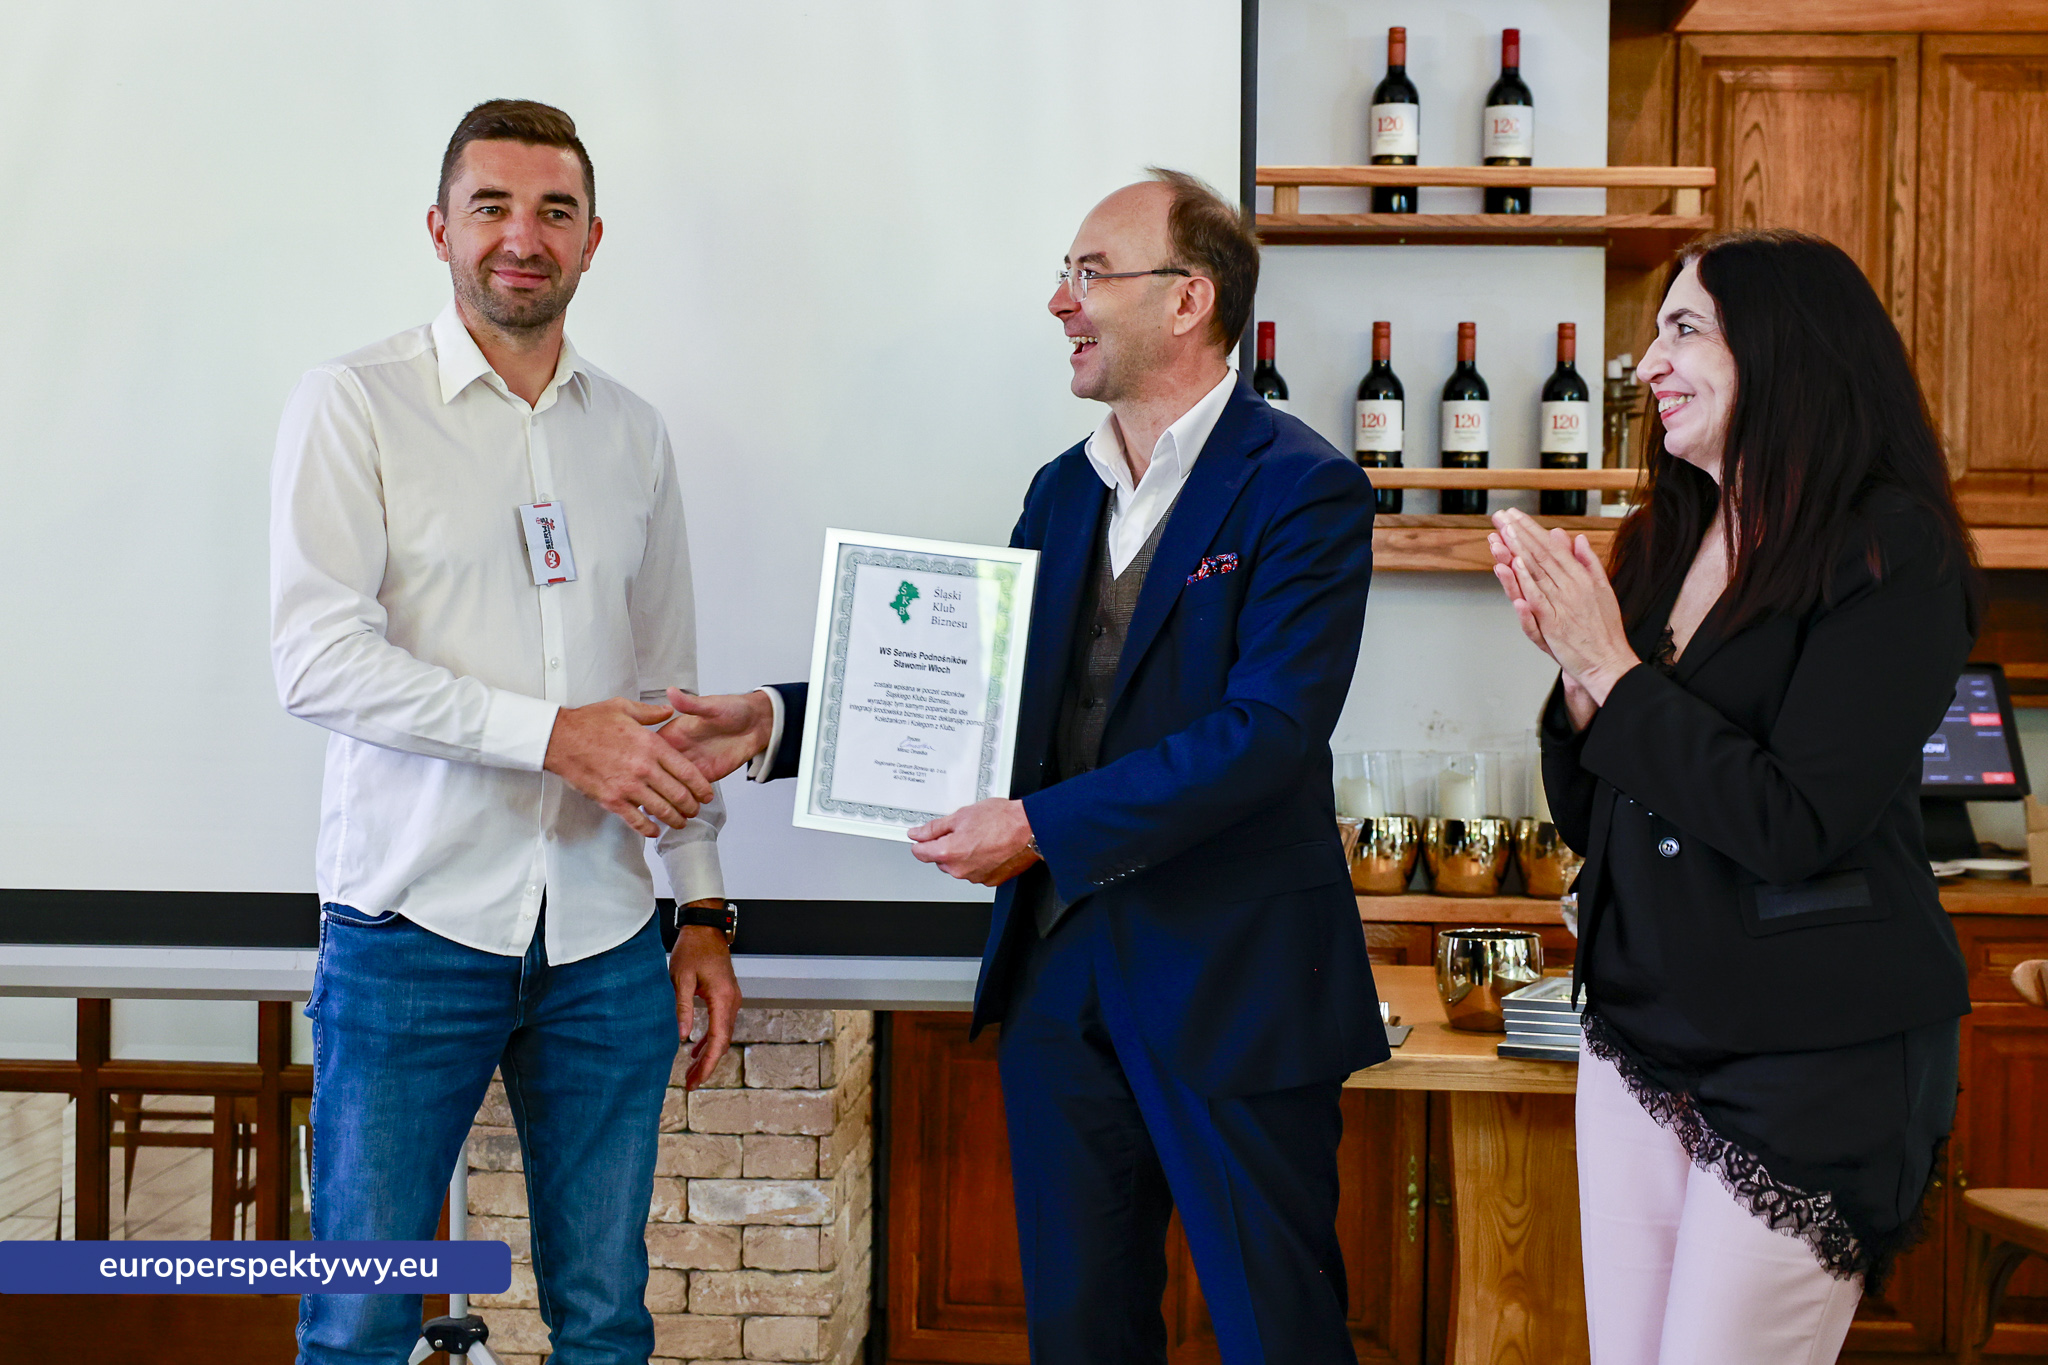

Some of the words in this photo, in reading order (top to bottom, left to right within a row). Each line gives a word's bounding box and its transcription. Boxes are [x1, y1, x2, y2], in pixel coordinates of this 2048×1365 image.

[1378, 116, 1403, 132] 120
[1361, 413, 1386, 428] 120
[1454, 414, 1480, 428] 120
[1552, 414, 1579, 430] 120
[934, 586, 962, 601] Śląski
[932, 602, 956, 614] Klub
[931, 616, 968, 628] Biznesu
[880, 646, 892, 655] WS
[893, 648, 917, 659] Serwis
[919, 652, 968, 665] Podnośników
[894, 660, 926, 671] Sławomir
